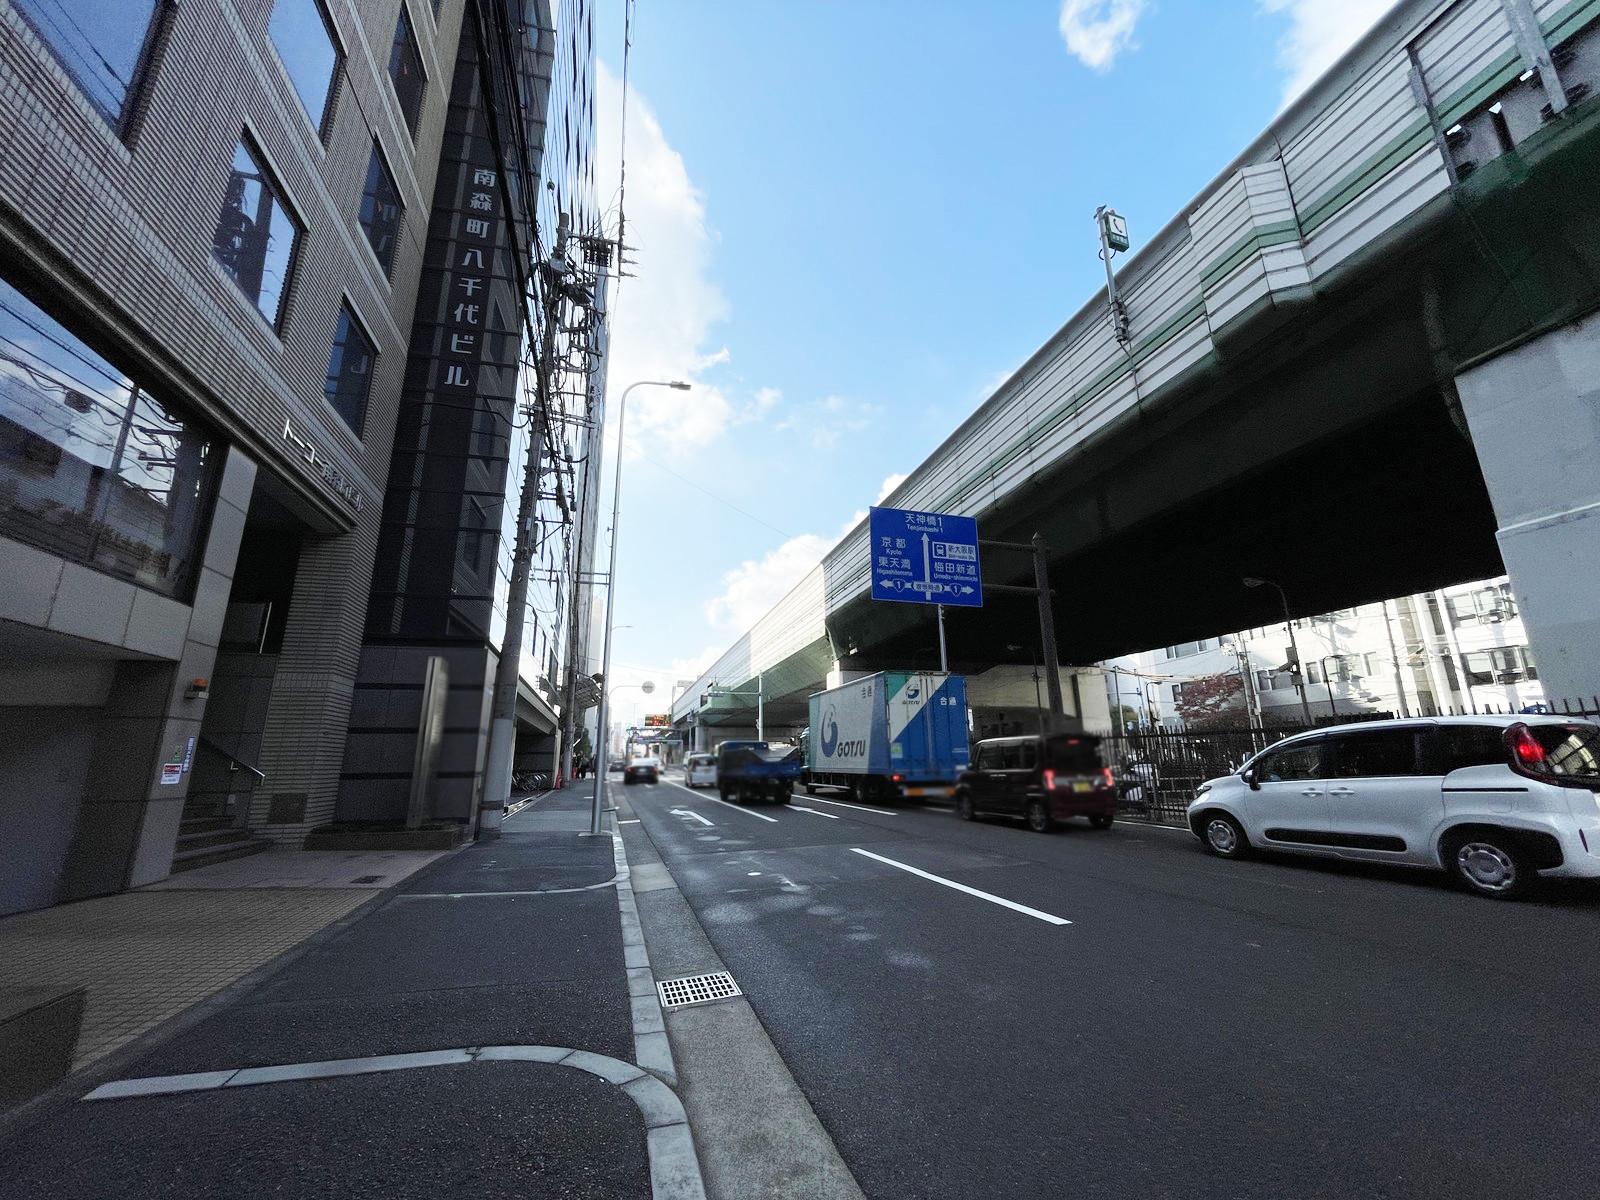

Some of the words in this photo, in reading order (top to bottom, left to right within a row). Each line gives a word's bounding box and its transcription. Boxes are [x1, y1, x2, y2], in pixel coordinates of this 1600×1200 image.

[443, 168, 498, 388] 南森町八千代ビル
[881, 537, 906, 549] 京都
[885, 548, 903, 556] Kyoto
[878, 556, 911, 570] 東天満
[837, 739, 867, 758] GOTSU
